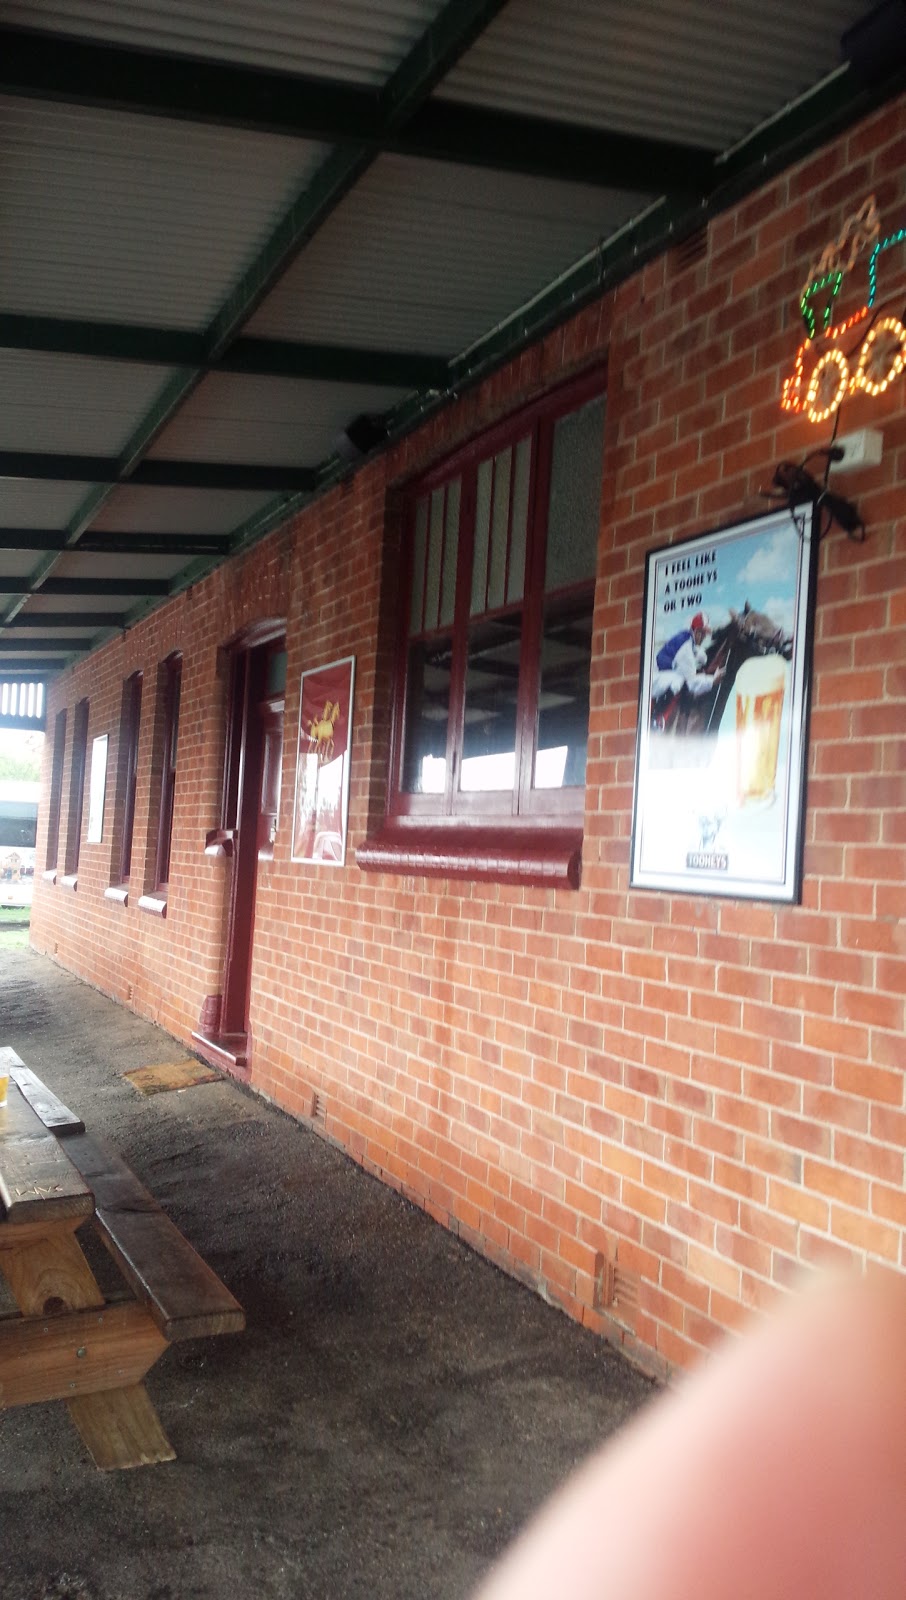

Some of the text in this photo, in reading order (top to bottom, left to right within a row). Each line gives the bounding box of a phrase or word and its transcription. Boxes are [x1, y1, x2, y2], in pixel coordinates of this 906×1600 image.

[672, 558, 690, 574] FEEL
[695, 551, 716, 567] LIKE
[665, 570, 717, 594] A TOOHEYS
[664, 593, 702, 612] OR TWO
